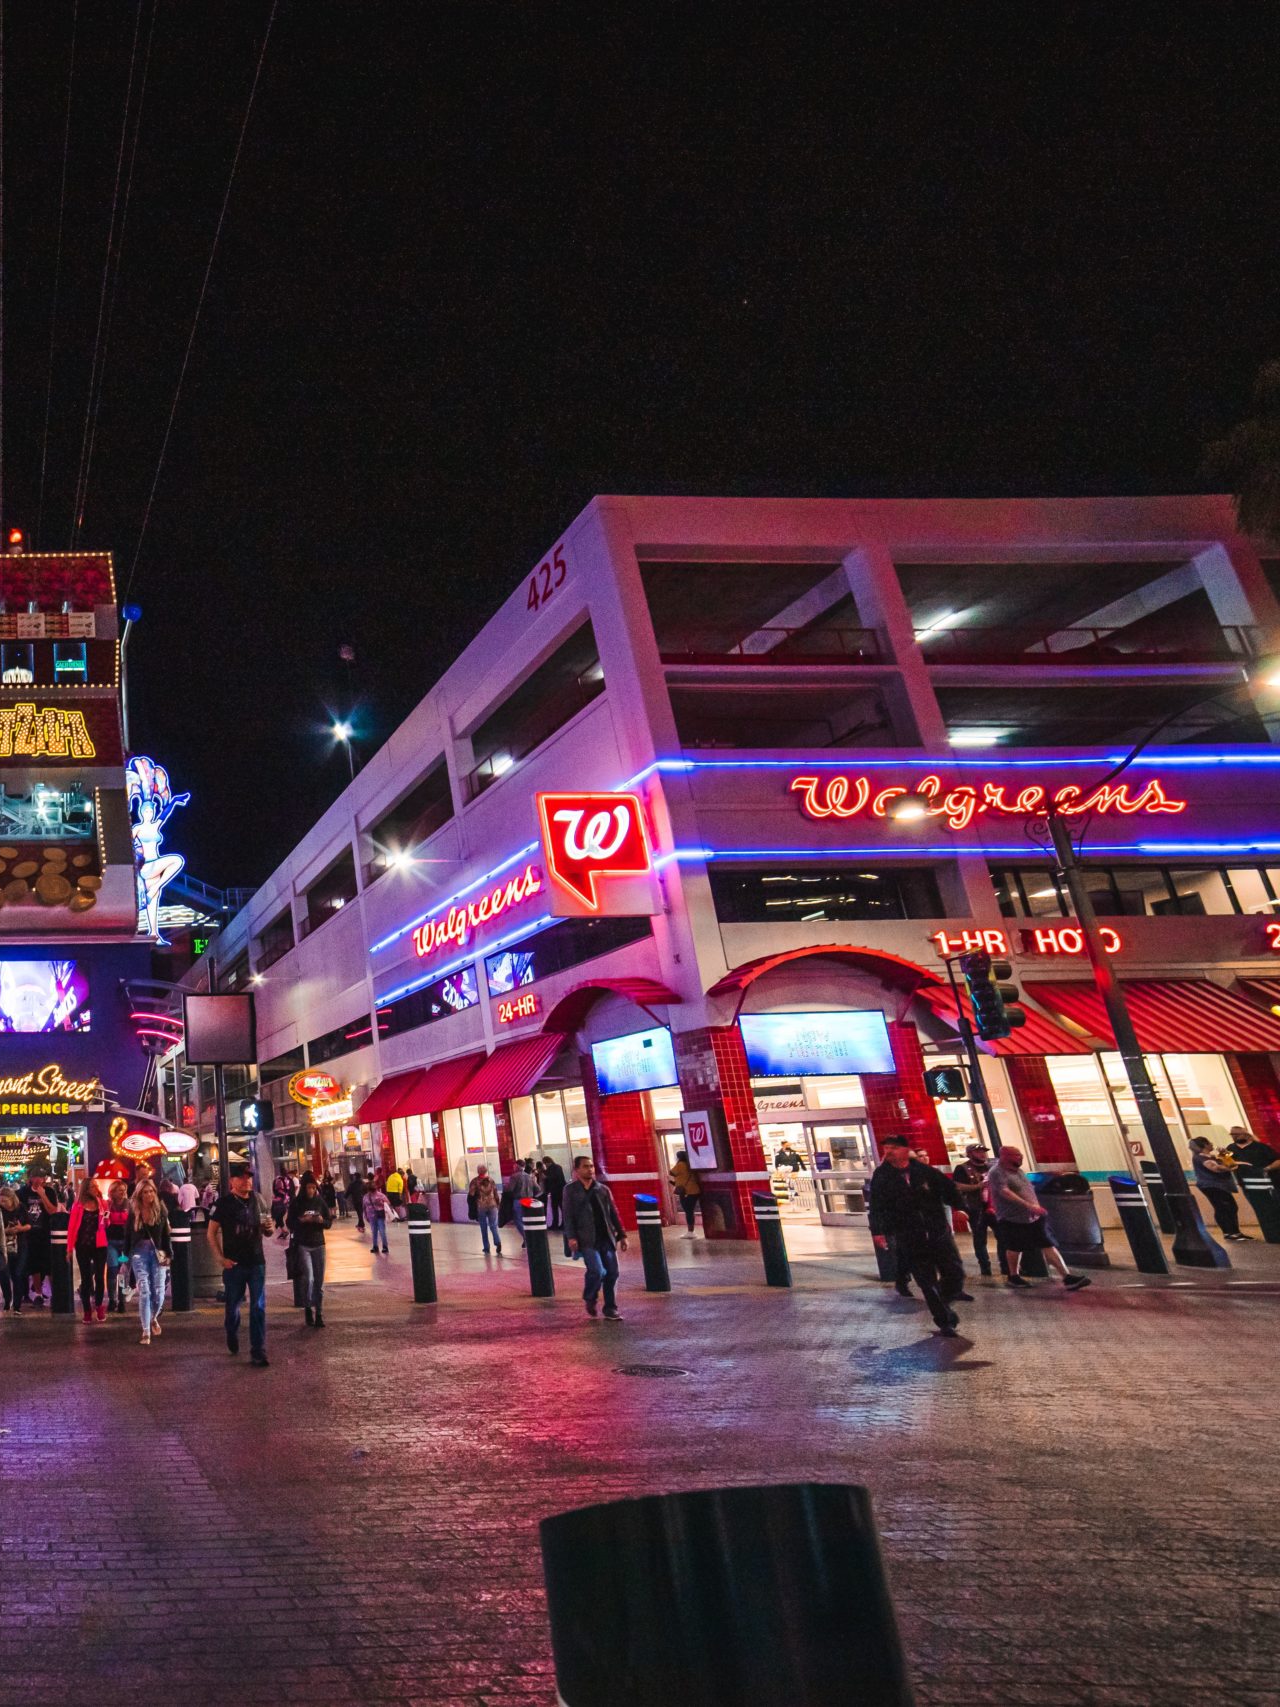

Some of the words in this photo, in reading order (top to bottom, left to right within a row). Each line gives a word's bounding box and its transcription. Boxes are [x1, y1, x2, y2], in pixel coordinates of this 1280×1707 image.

[527, 543, 566, 611] 425
[791, 775, 1187, 834] Walgreens
[553, 805, 630, 860] W
[412, 864, 541, 957] Walgreens
[934, 929, 1006, 954] 1-HR
[499, 994, 536, 1023] 24-HR
[33, 1064, 97, 1101] Street
